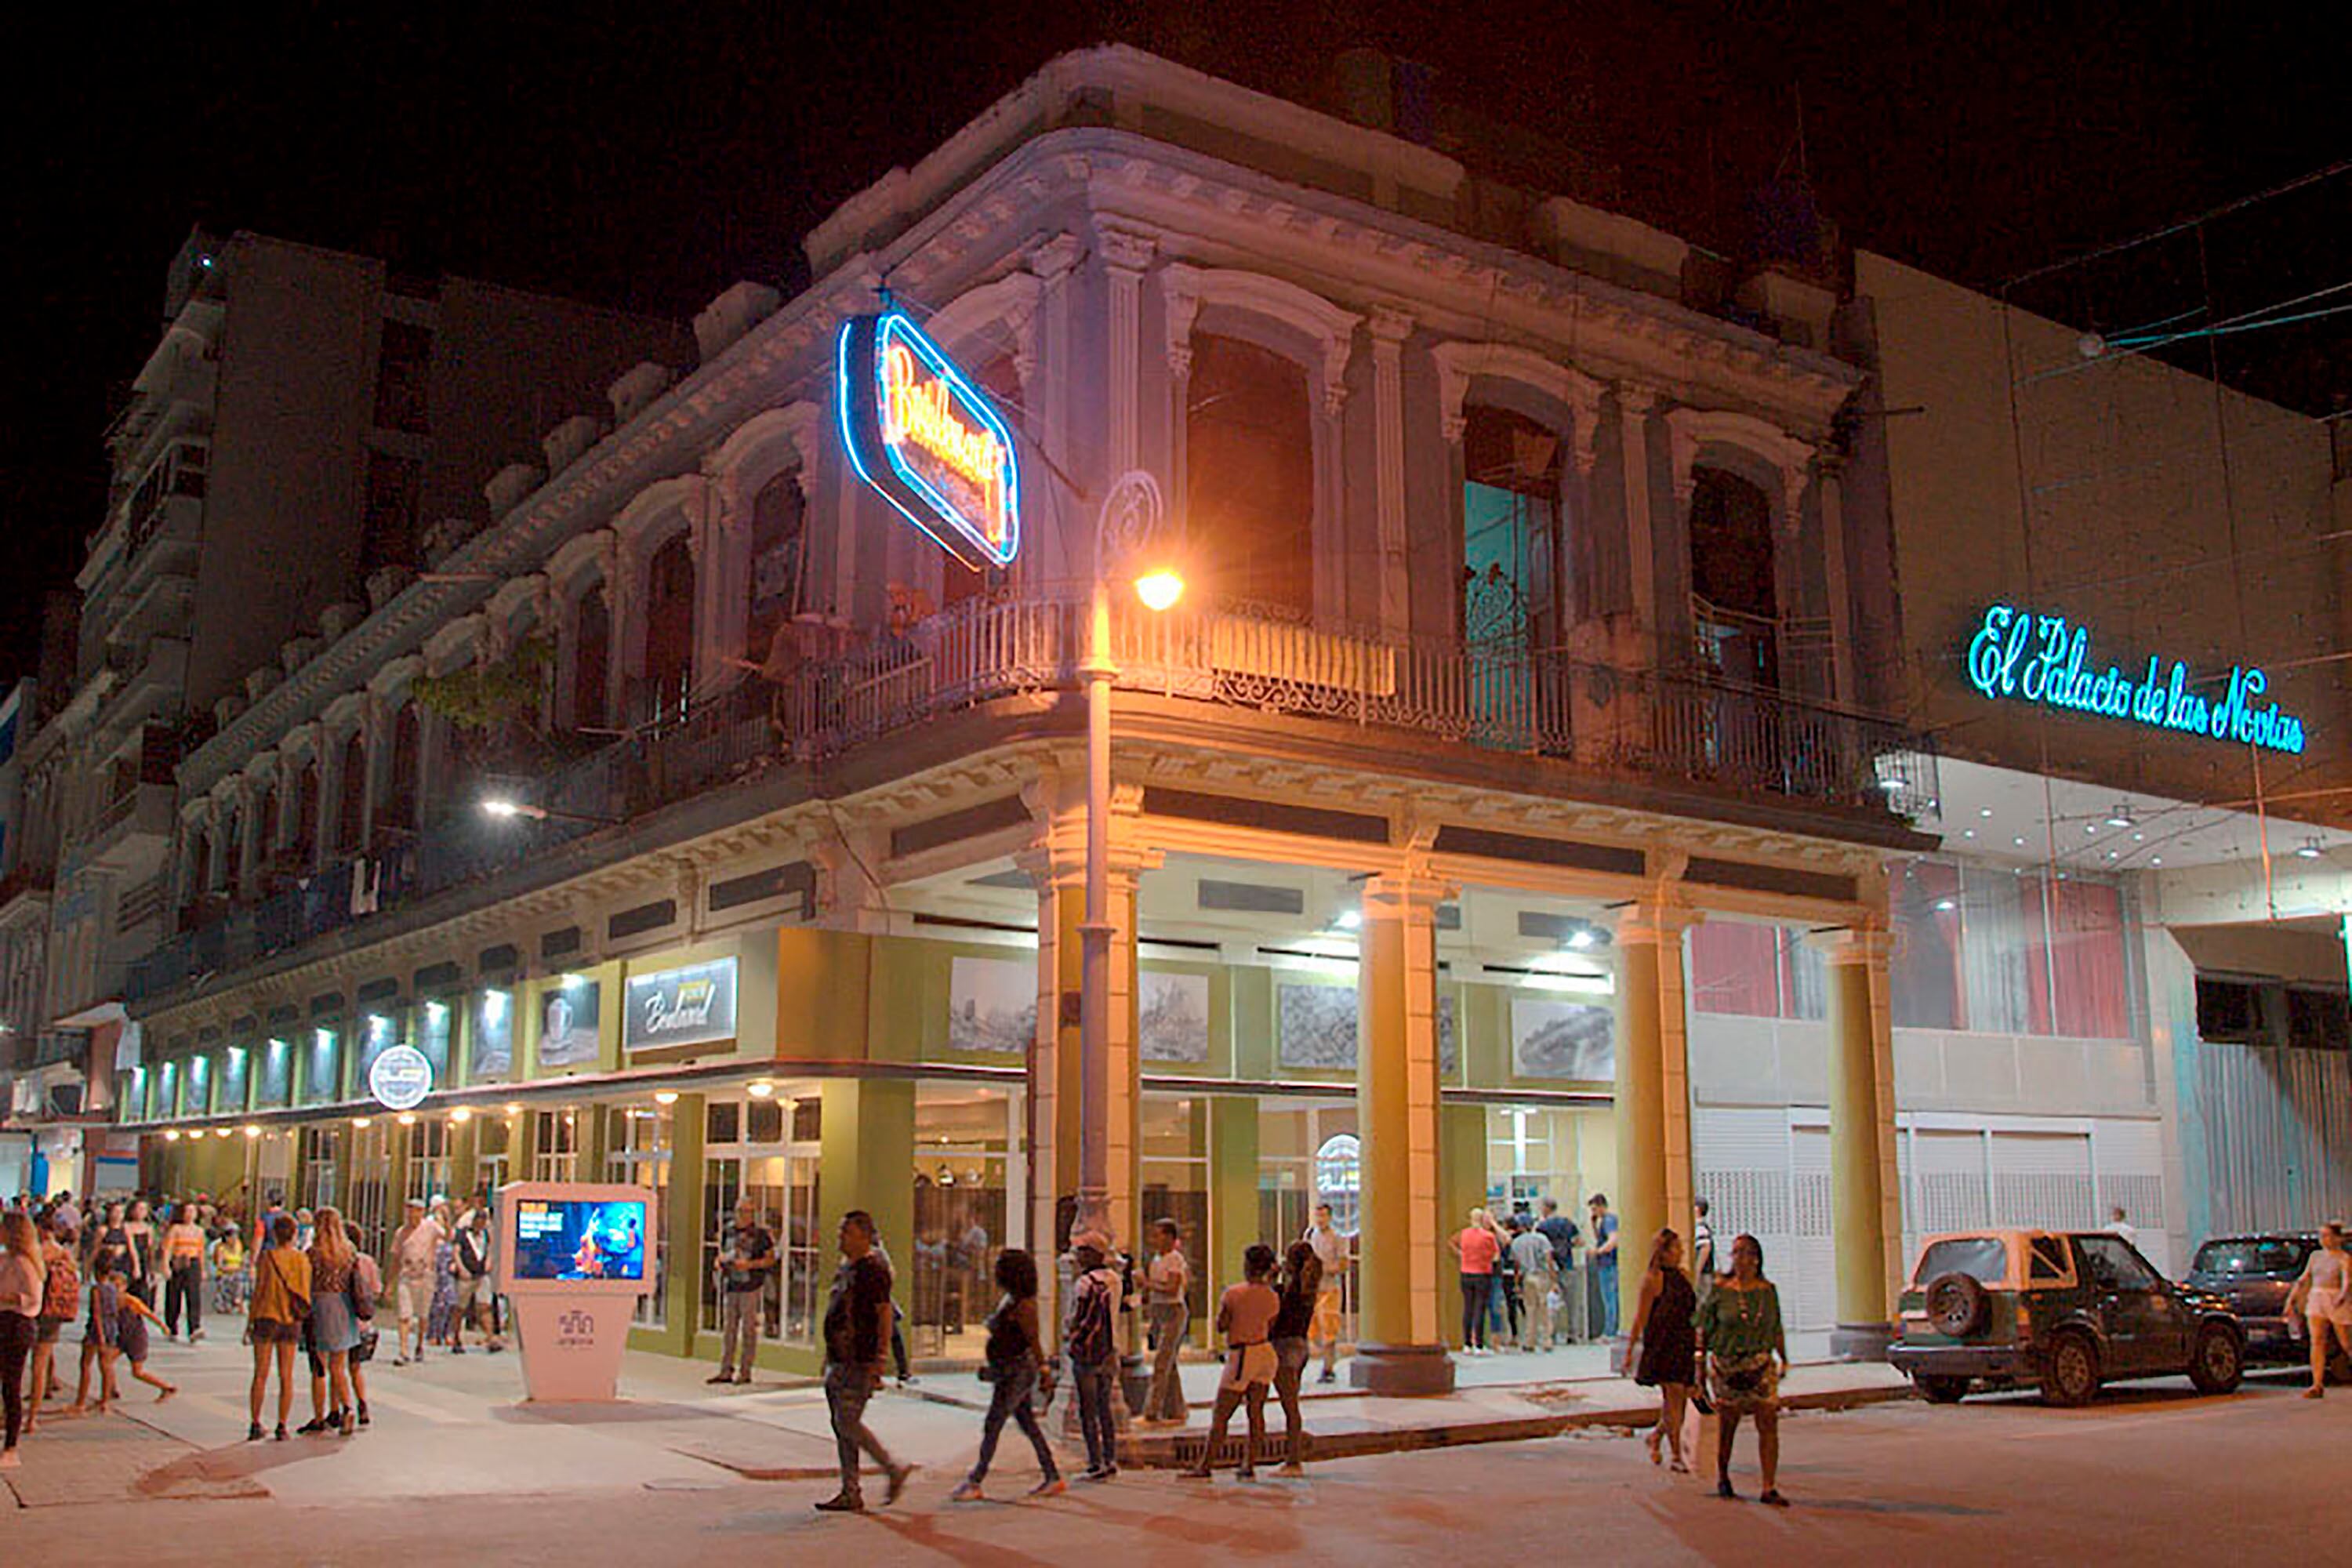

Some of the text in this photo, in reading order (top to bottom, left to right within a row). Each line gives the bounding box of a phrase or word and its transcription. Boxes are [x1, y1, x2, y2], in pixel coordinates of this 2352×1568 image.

[1969, 605, 2306, 753] El Palacio de las Novias
